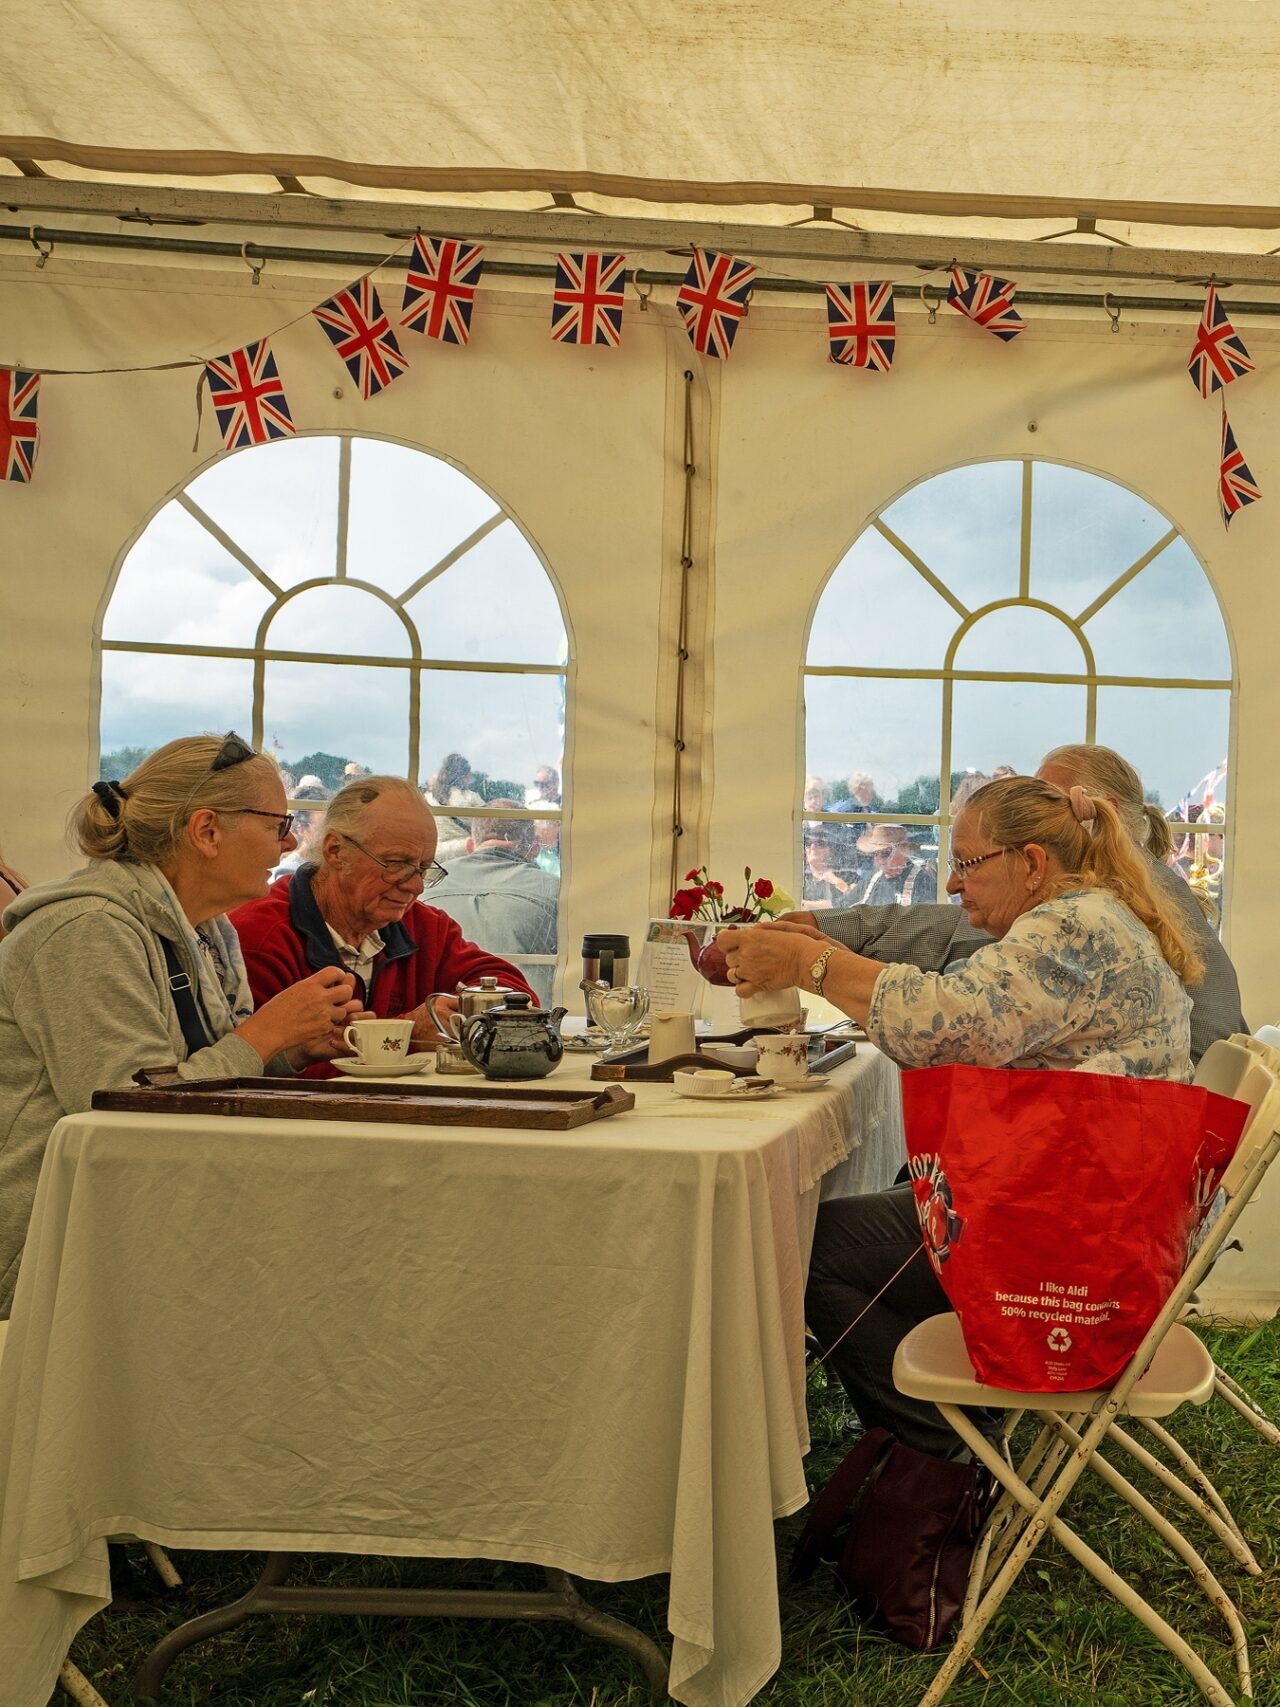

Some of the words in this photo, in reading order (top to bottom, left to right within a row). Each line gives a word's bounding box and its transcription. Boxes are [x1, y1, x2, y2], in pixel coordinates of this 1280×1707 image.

[1040, 1282, 1043, 1291] I
[1046, 1282, 1064, 1294] like
[1067, 1285, 1088, 1297] Aldi
[995, 1291, 1039, 1305] because
[1041, 1296, 1060, 1308] this
[1062, 1298, 1083, 1312] bag
[1001, 1306, 1026, 1318] 50%
[1028, 1309, 1072, 1323] recycled
